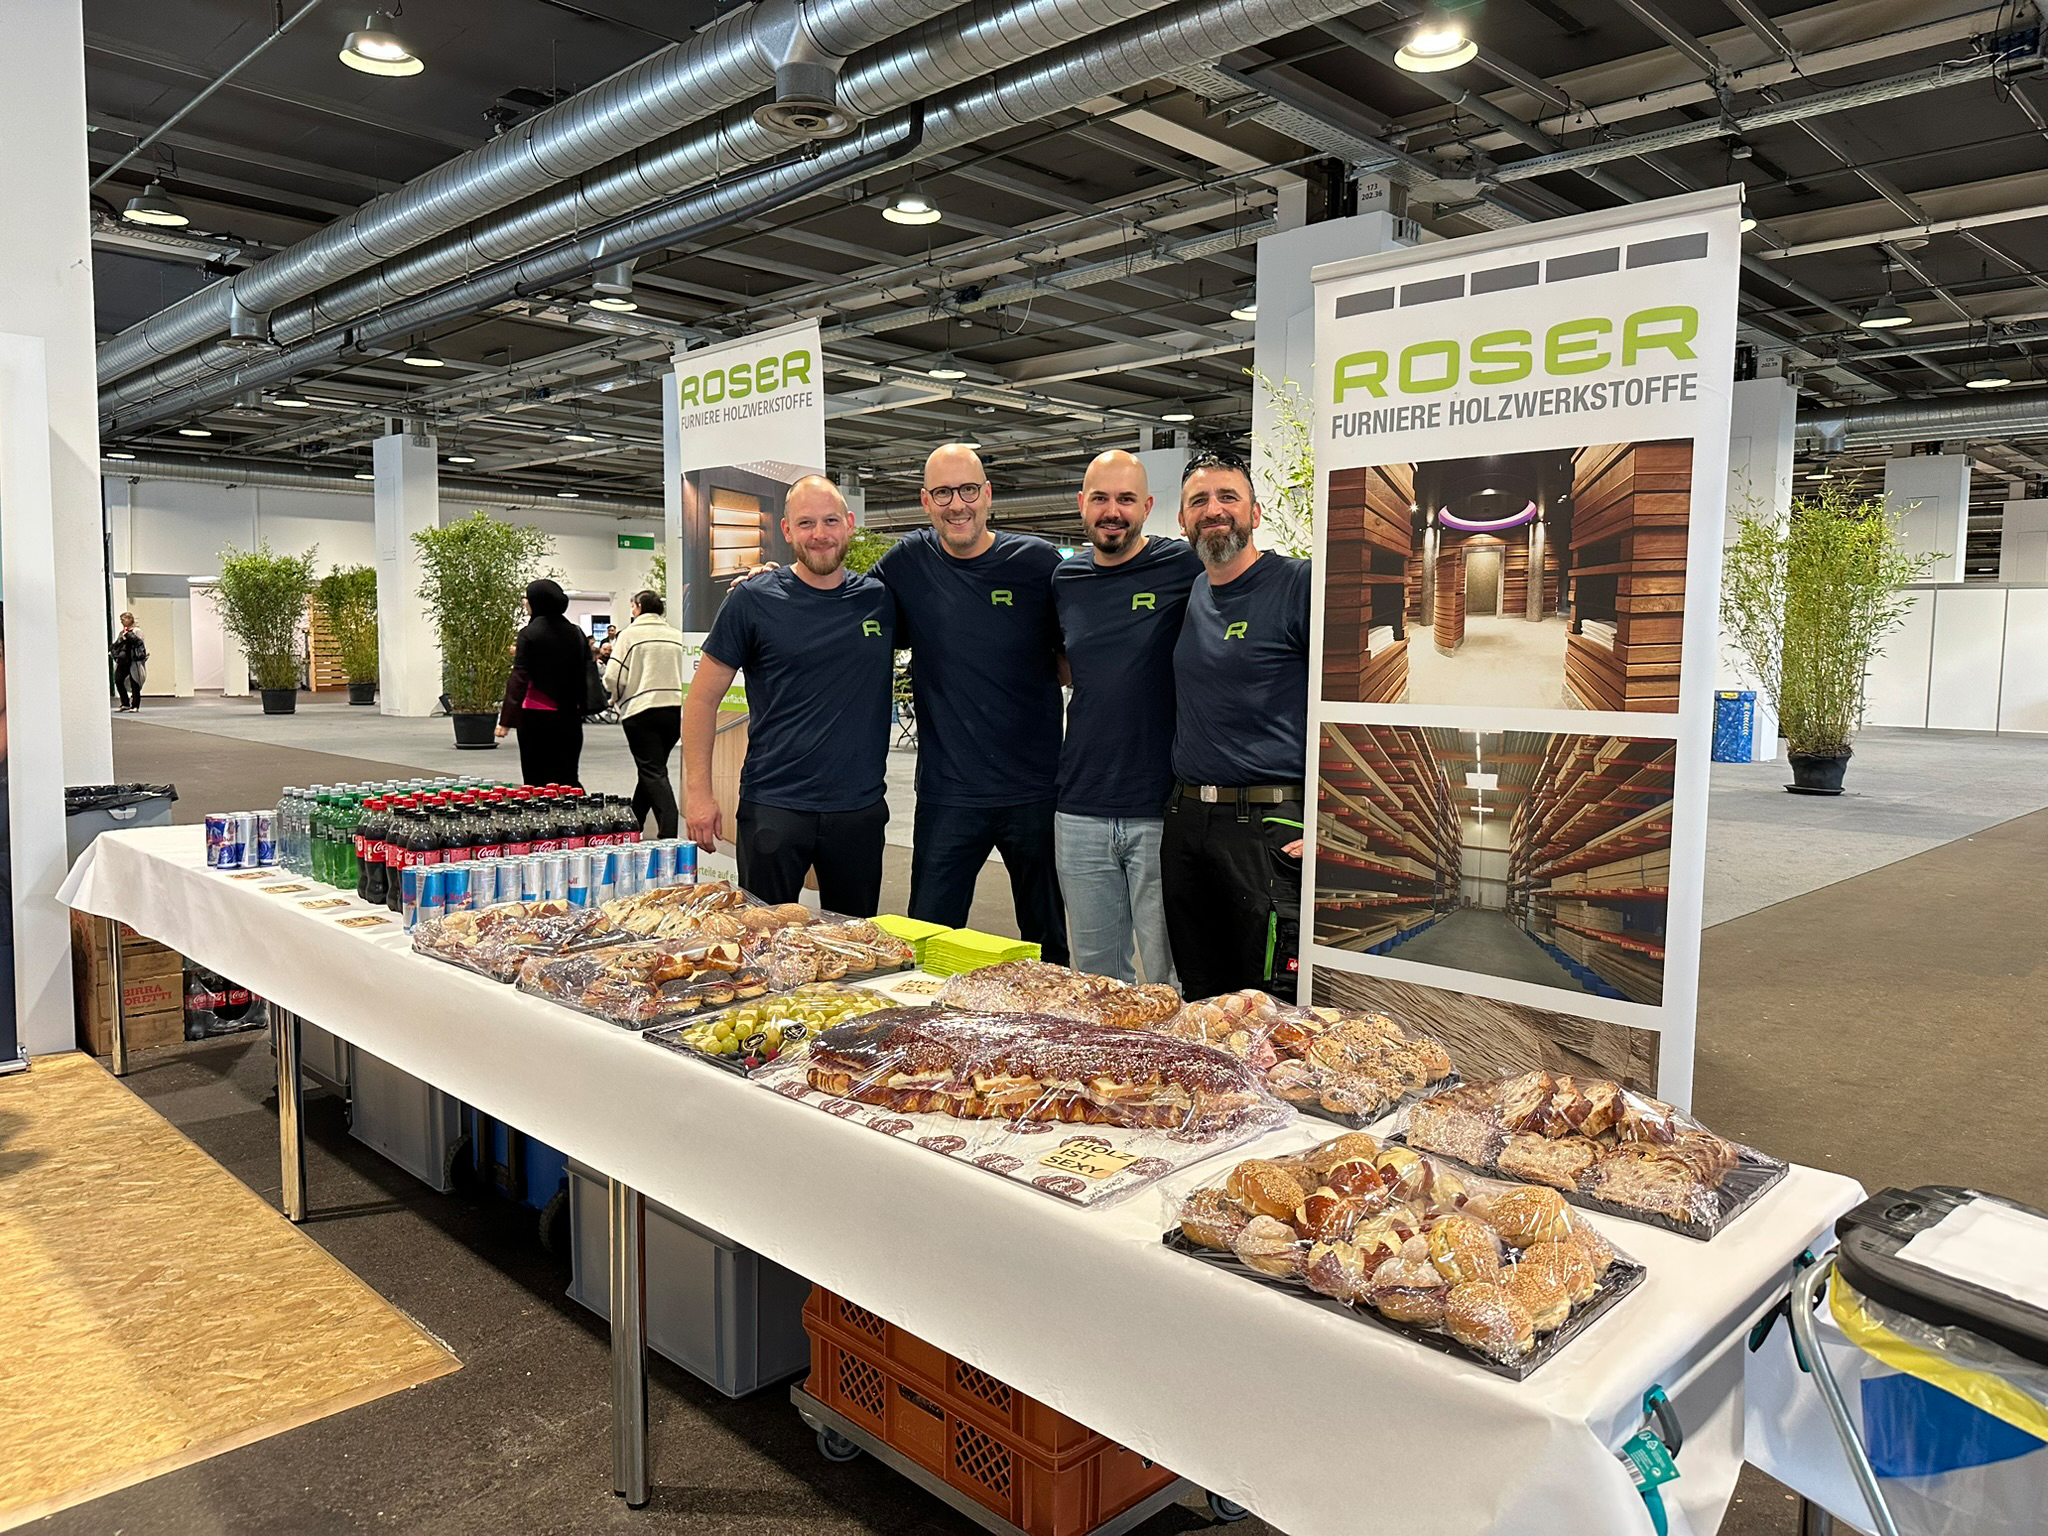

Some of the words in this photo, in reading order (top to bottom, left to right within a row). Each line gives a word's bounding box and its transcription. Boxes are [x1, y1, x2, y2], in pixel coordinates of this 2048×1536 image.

[1366, 183, 1378, 191] 173
[1333, 305, 1699, 404] ROSER
[681, 349, 811, 410] ROSER
[681, 408, 721, 430] FURNIERE
[723, 391, 813, 422] HOLZWERKSTOFFE
[1331, 402, 1441, 440] FURNIERE
[1449, 372, 1698, 427] HOLZWERKSTOFFE
[990, 589, 1013, 606] R
[1132, 592, 1155, 611] R
[861, 620, 882, 637] R
[1223, 621, 1248, 640] R
[124, 984, 162, 998] BIRRA
[124, 991, 172, 1006] ORETTI
[1060, 1148, 1096, 1161] IST
[1074, 1141, 1136, 1161] HOLZ
[1045, 1156, 1105, 1174] SEXY
